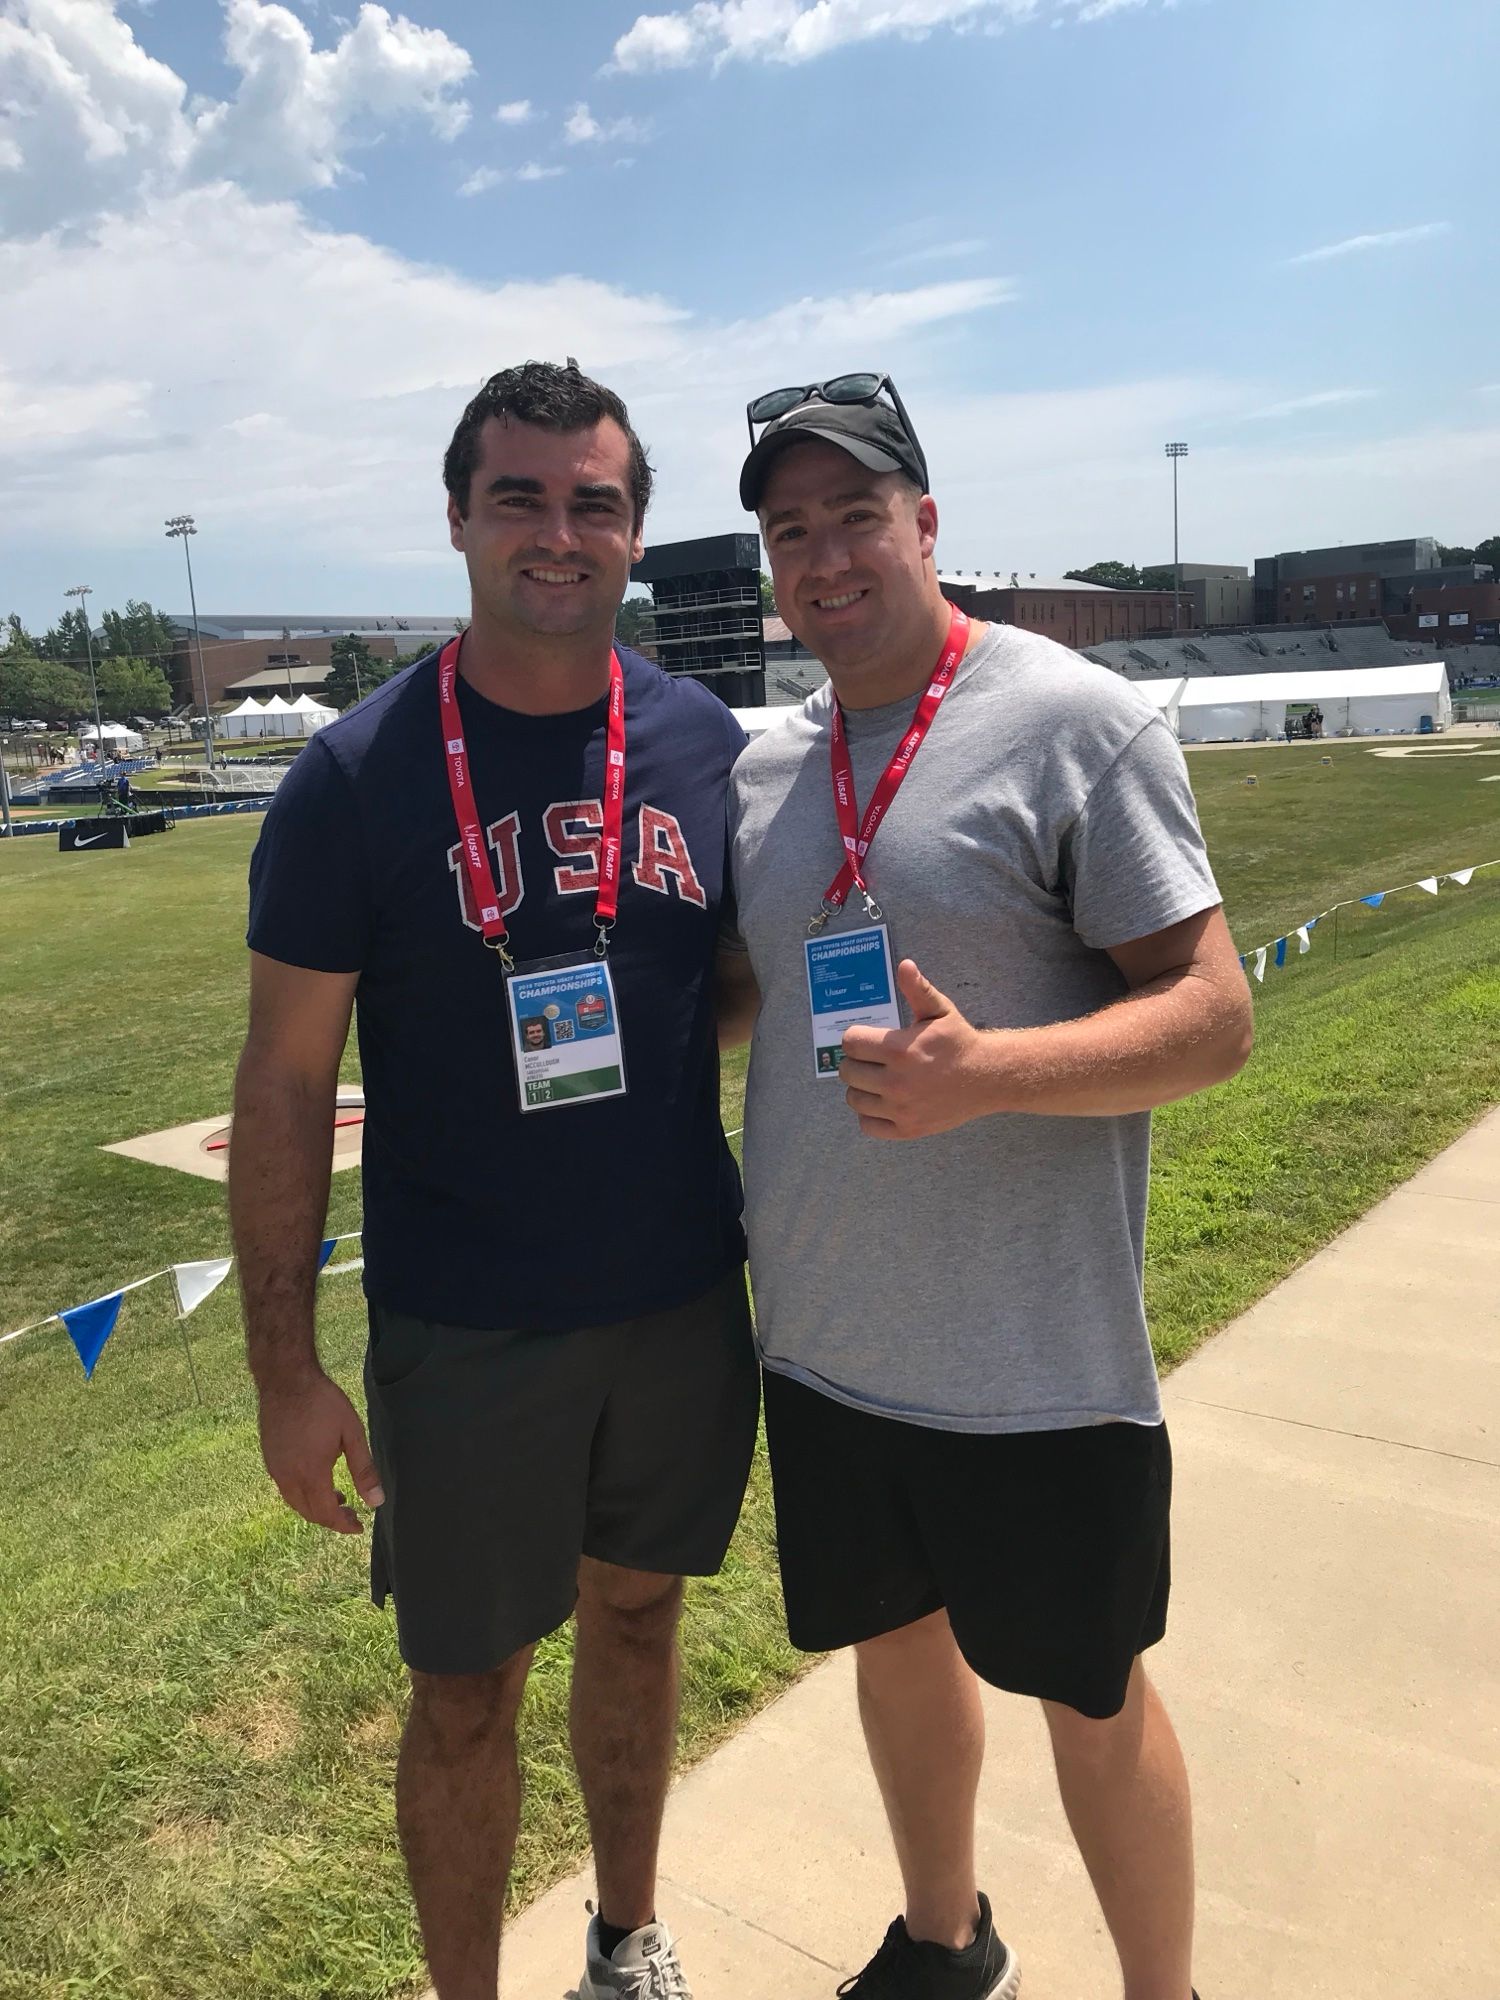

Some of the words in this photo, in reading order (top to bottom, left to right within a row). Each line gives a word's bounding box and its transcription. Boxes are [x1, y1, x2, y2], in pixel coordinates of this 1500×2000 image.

[938, 652, 957, 682] TOYOTA
[441, 674, 451, 704] USATF
[611, 687, 622, 718] USATF
[902, 731, 921, 759] USATF
[453, 756, 465, 788] TOYOTA
[612, 768, 620, 801] TOYOTA
[836, 781, 848, 806] USATF
[862, 805, 882, 838] TOYOTA
[447, 799, 707, 932] USA
[468, 836, 482, 869] USATF
[605, 849, 616, 880] USATF
[811, 941, 880, 961] CHAMPIONSHIPS
[519, 976, 603, 999] CHAMPIONSHIPS
[527, 1080, 551, 1091] TEAM
[643, 1933, 657, 1948] NIKE
